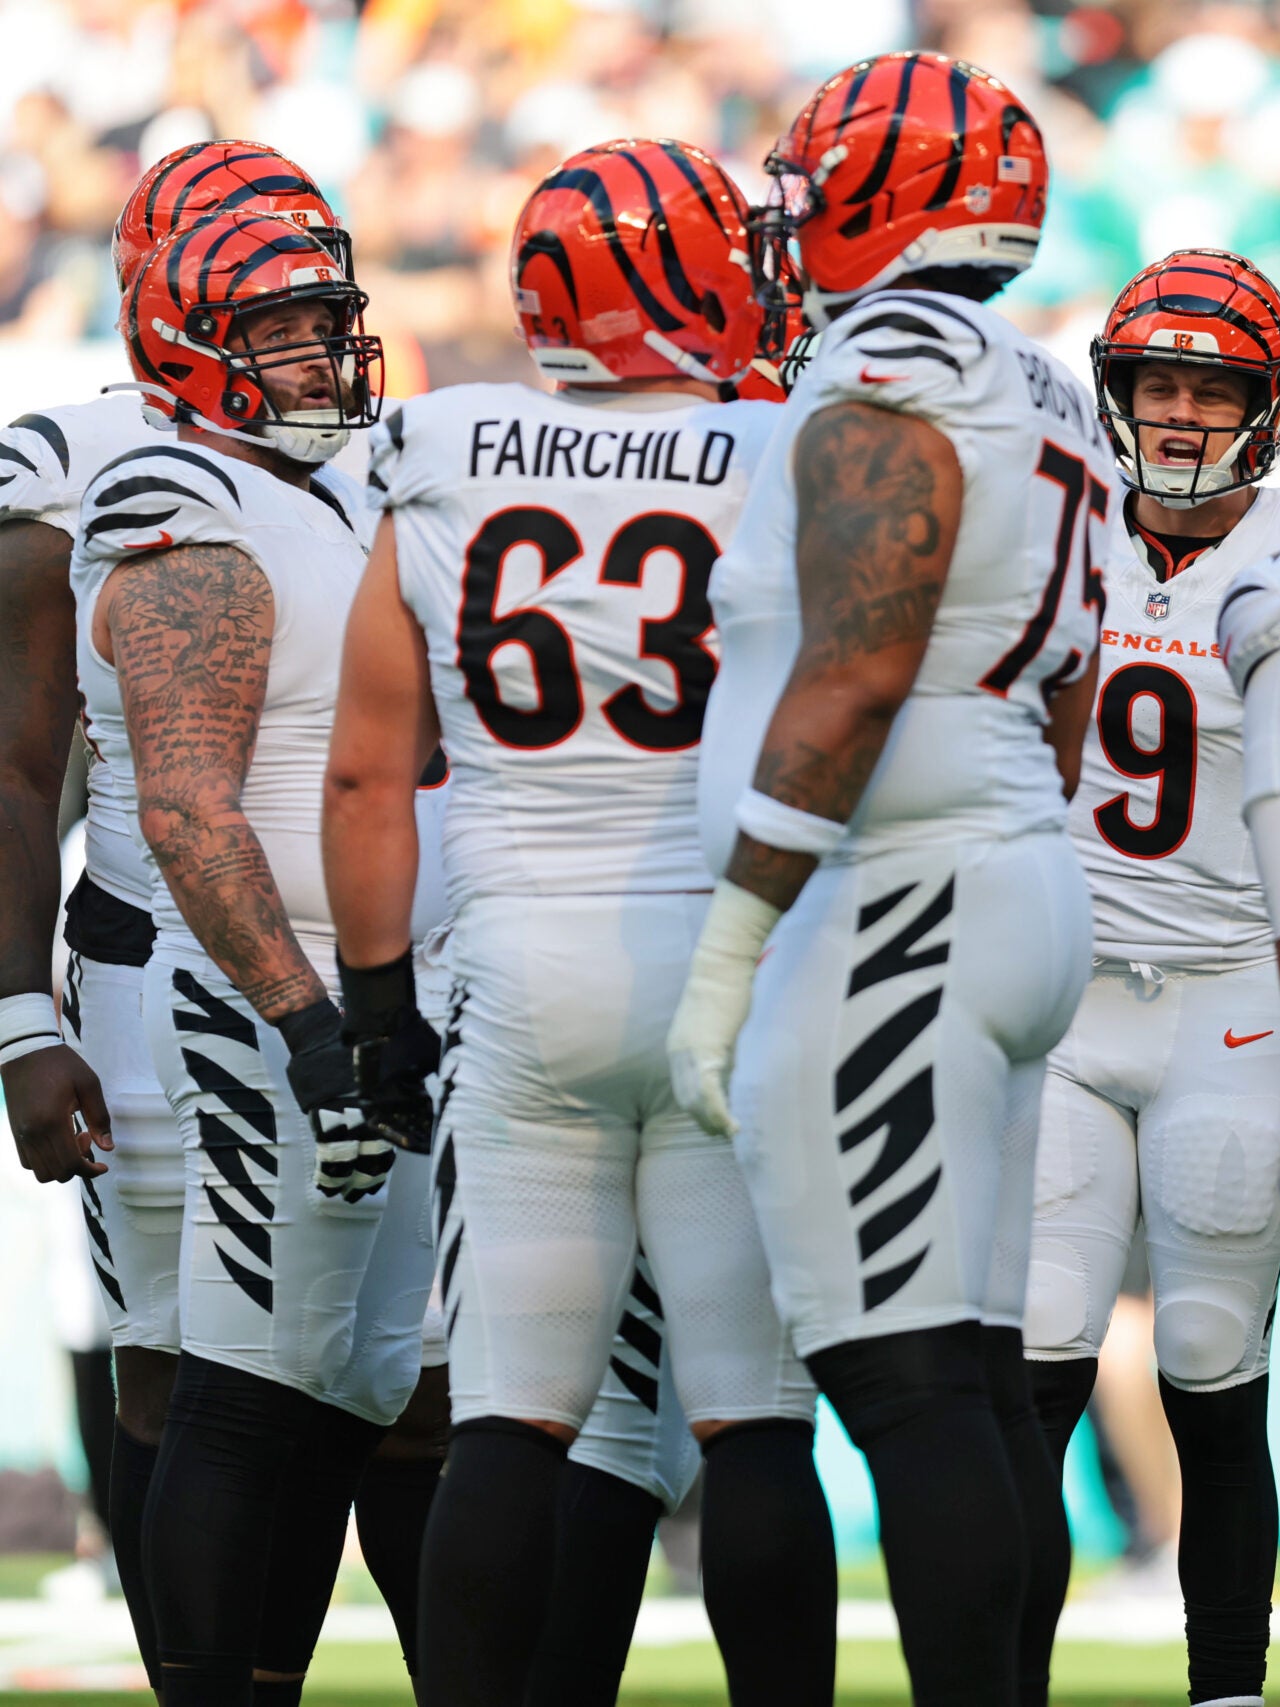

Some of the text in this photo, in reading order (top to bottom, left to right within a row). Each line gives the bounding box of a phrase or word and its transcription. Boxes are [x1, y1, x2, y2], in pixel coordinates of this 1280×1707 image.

[468, 419, 736, 487] FAIRCHILD
[456, 504, 722, 753] 63
[1101, 629, 1222, 659] ENGALS
[1093, 661, 1198, 861] 9
